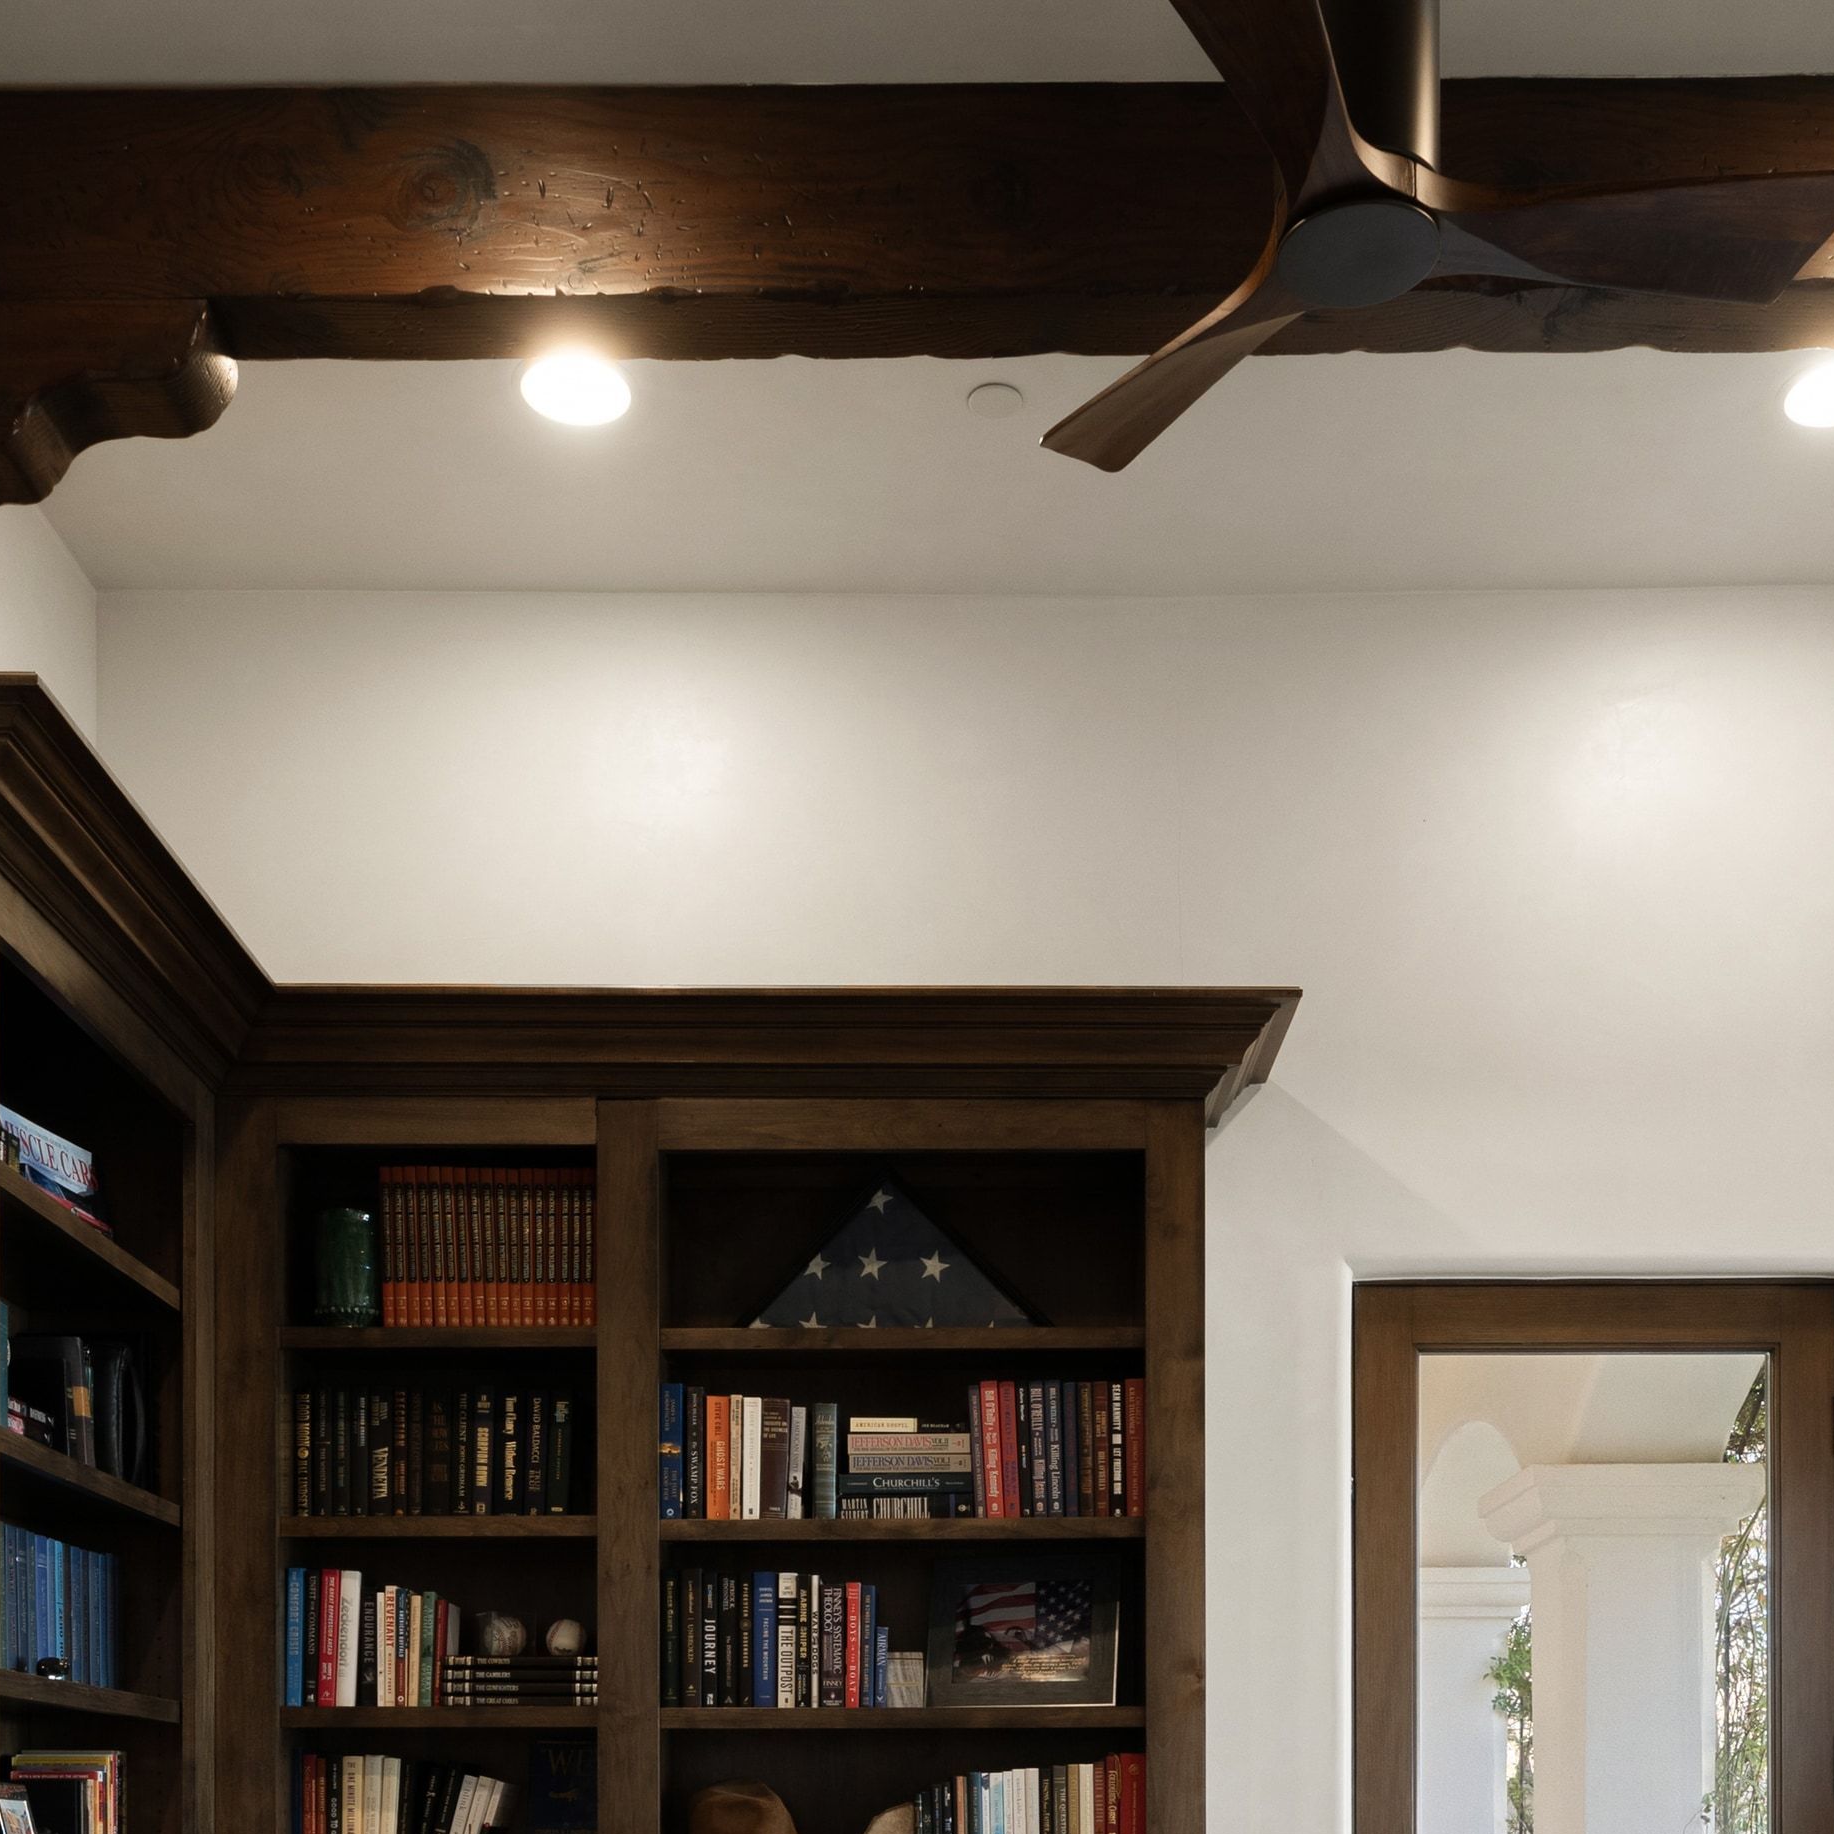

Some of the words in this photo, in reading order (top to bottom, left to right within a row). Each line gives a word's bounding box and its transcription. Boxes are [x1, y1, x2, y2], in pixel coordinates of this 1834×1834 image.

[503, 1396, 518, 1412] Tom
[1111, 1384, 1122, 1401] SEAN
[294, 1394, 310, 1421] BLOOD
[531, 1397, 542, 1423] DAVID
[1111, 1402, 1123, 1431] HANNITY
[296, 1422, 310, 1447] MOON
[457, 1410, 468, 1442] CLIENT
[501, 1413, 518, 1436] Clancy
[530, 1424, 541, 1464] BALDACCI
[716, 1440, 726, 1467] GHOST
[851, 1436, 903, 1449] JEFFERSON
[907, 1435, 932, 1448] DAVIS
[690, 1451, 700, 1482] SWAMP
[853, 1455, 905, 1468] JEFFERSON
[908, 1455, 934, 1467] DAVIS
[986, 1448, 998, 1468] Killing
[1049, 1444, 1061, 1471] Killing
[371, 1446, 388, 1500] VENDETTA
[457, 1463, 467, 1497] GRISHAM
[716, 1468, 725, 1491] WARS
[872, 1476, 941, 1489] CHURCHILL'S
[988, 1470, 1000, 1498] Kennedy
[1050, 1471, 1061, 1499] Lincoln
[297, 1477, 309, 1508] LINDSEY
[689, 1485, 700, 1505] FOX
[841, 1497, 869, 1510] MARTIN
[872, 1497, 931, 1520] CHURCHILL
[288, 1582, 299, 1622] COMFORT
[798, 1588, 808, 1623] MARINE
[823, 1587, 833, 1633] THEOLOGY
[831, 1587, 843, 1622] FINNEY'S
[307, 1611, 317, 1655] COMMAND
[363, 1602, 375, 1664] ENDURANCE
[386, 1596, 395, 1648] REVENANT
[811, 1610, 819, 1635] WAR
[849, 1615, 859, 1643] BOYS
[288, 1626, 298, 1656] CRISIS
[704, 1618, 716, 1674] JOURNEY
[780, 1629, 794, 1647] THE
[798, 1626, 808, 1659] SNIPER
[832, 1625, 843, 1674] SYSTEMATIC
[876, 1632, 887, 1666] AIRMAN
[780, 1650, 794, 1695] OUTPOST
[811, 1647, 819, 1676] DOGS
[849, 1665, 859, 1694] BOAT
[330, 1797, 338, 1818] GOOD
